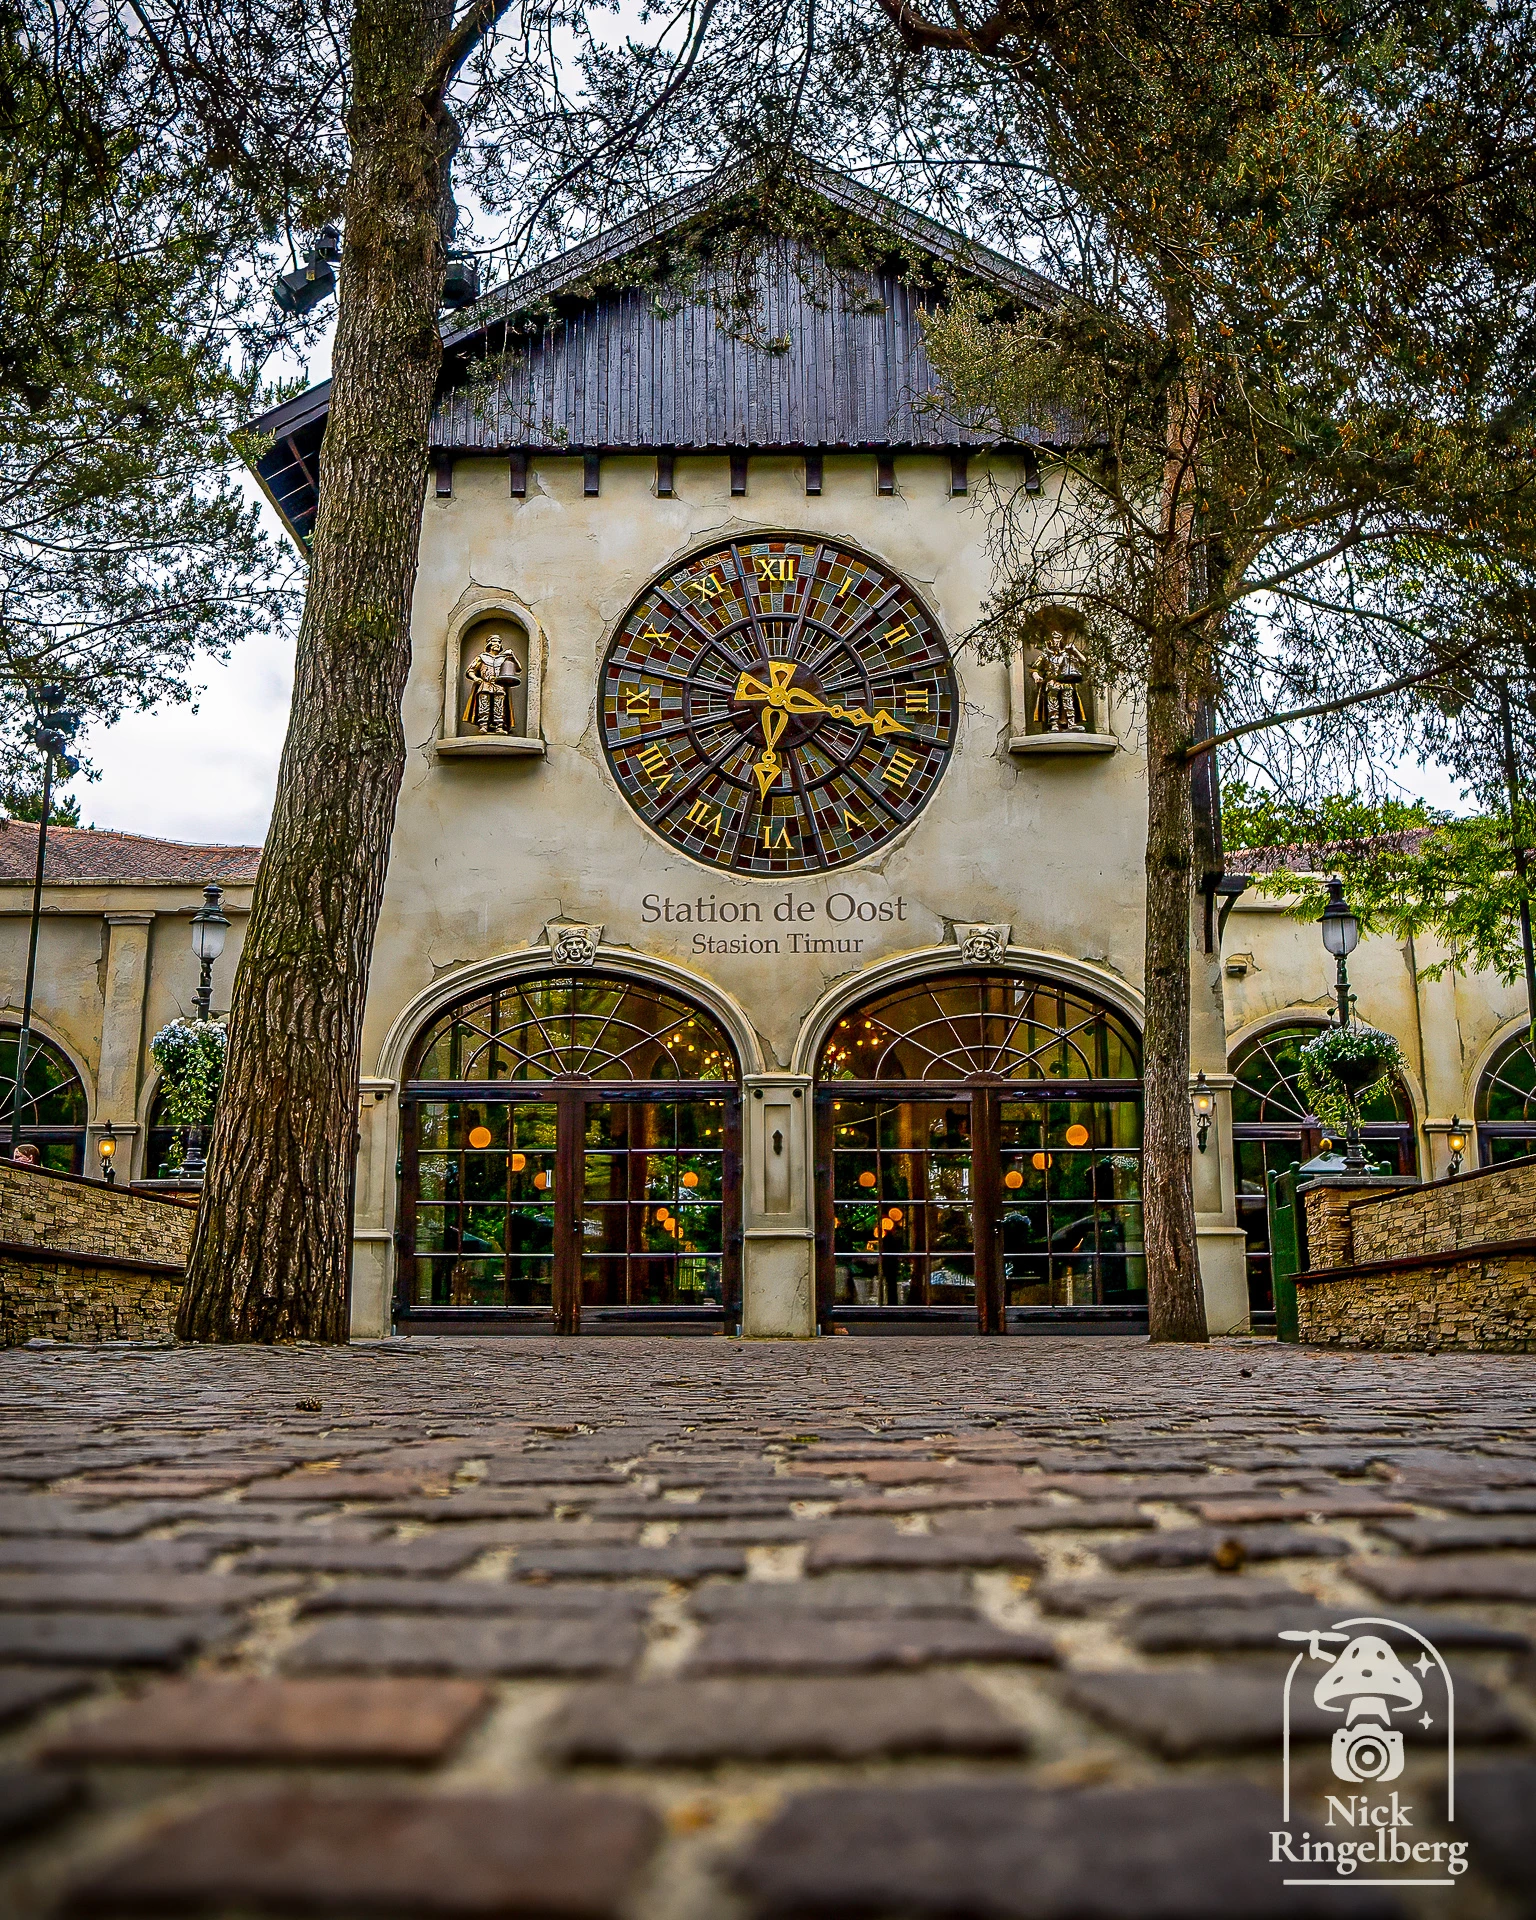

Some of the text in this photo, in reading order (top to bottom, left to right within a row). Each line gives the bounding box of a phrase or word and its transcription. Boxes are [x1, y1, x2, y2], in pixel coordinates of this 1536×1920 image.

[758, 559, 795, 581] XII
[691, 572, 725, 602] XI
[837, 577, 854, 598] I
[644, 623, 671, 648] X
[883, 623, 911, 647] II
[626, 687, 650, 715] IX
[904, 688, 929, 713] III
[636, 744, 675, 794] VIII
[881, 749, 918, 788] IIII
[684, 802, 722, 837] VII
[842, 808, 866, 833] V
[763, 826, 794, 849] VI
[641, 892, 908, 923] Station de Oost
[692, 933, 863, 954] Stasion Timur
